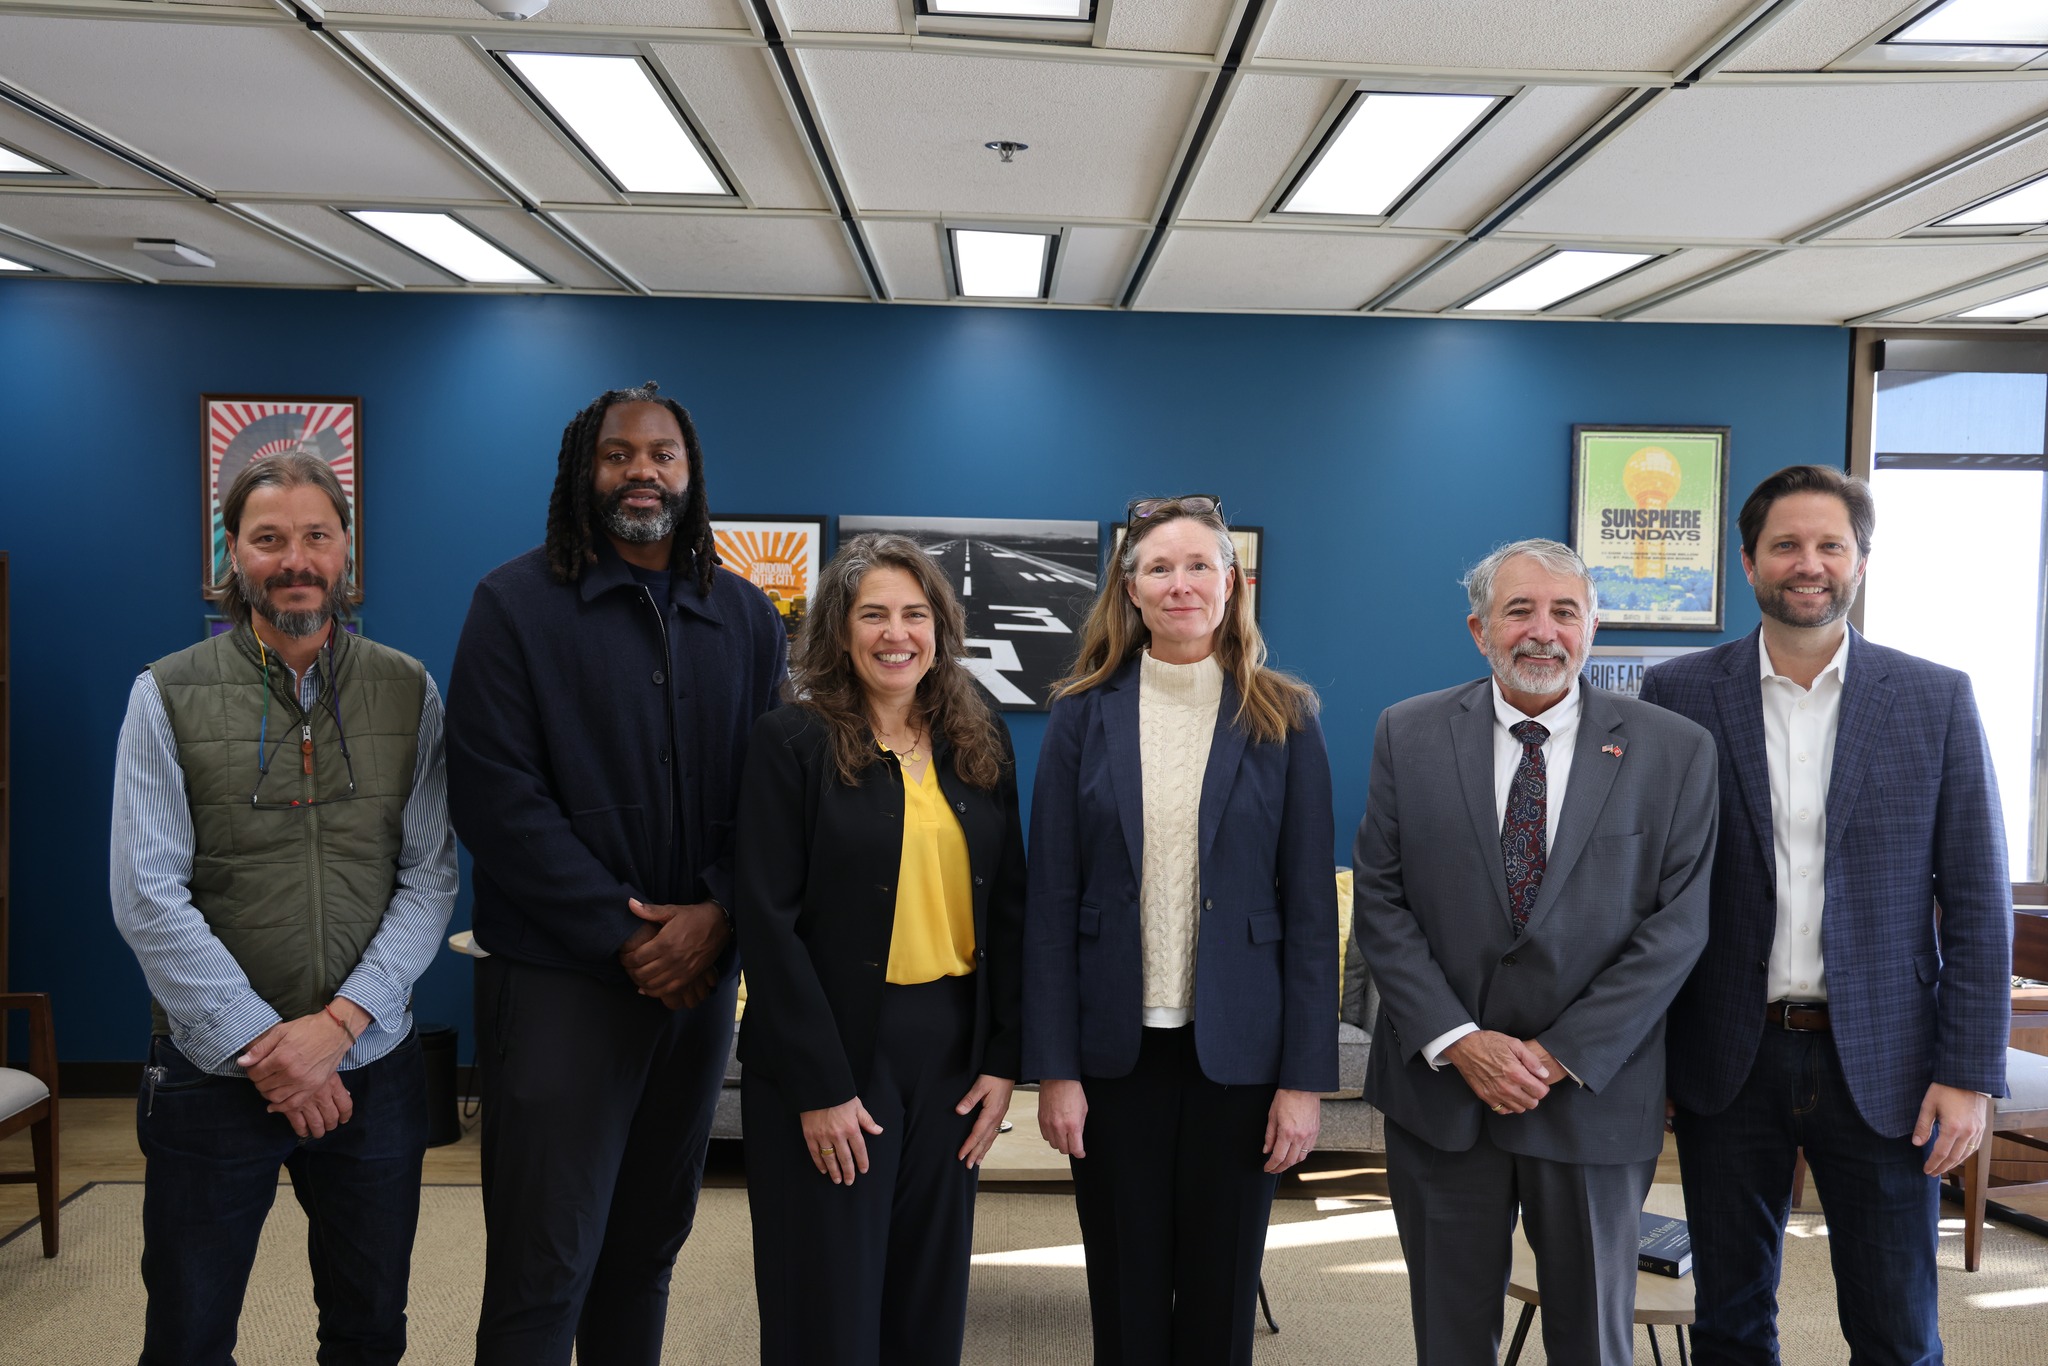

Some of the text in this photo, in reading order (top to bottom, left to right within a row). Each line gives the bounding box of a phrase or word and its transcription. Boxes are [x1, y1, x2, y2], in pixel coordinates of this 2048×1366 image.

[1601, 508, 1700, 529] SUNSPHERE
[1601, 529, 1700, 541] SUNDAYS
[751, 562, 792, 575] SUNDOWN
[760, 574, 776, 586] THE
[776, 574, 796, 586] CITY
[1591, 664, 1615, 691] BIG
[1638, 1260, 1654, 1268] nor
